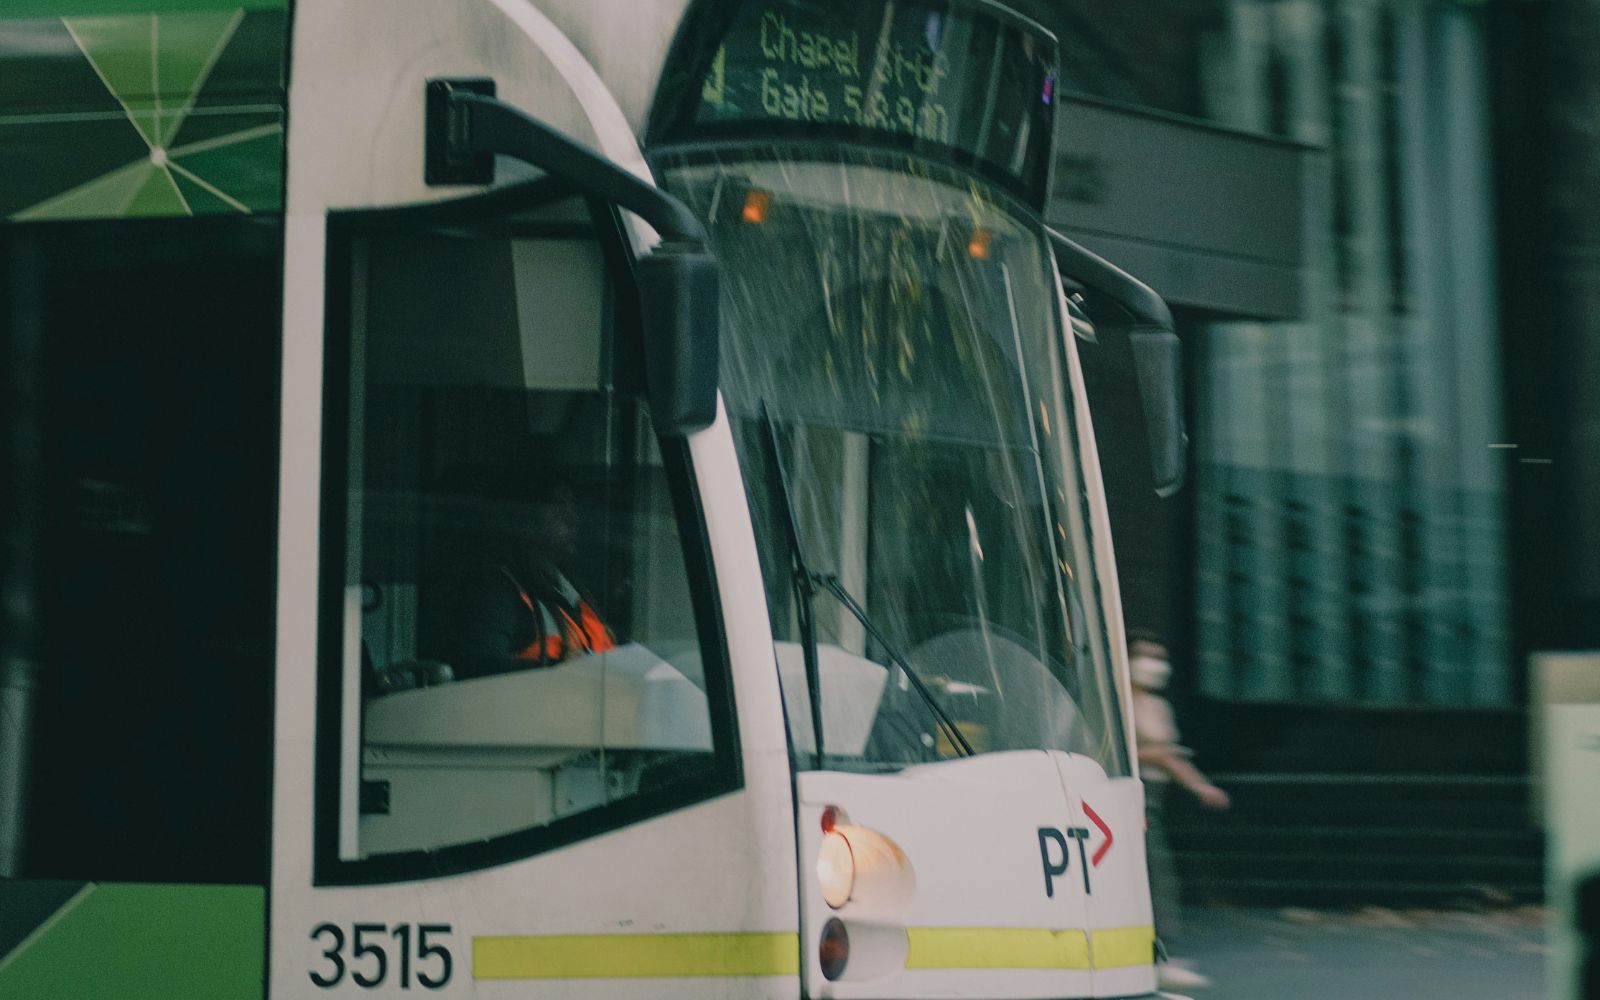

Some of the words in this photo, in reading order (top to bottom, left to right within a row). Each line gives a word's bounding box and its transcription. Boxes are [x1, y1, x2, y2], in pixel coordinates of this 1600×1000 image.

[761, 12, 860, 79] Chapel
[762, 67, 830, 122] Gate
[308, 922, 453, 989] 3515
